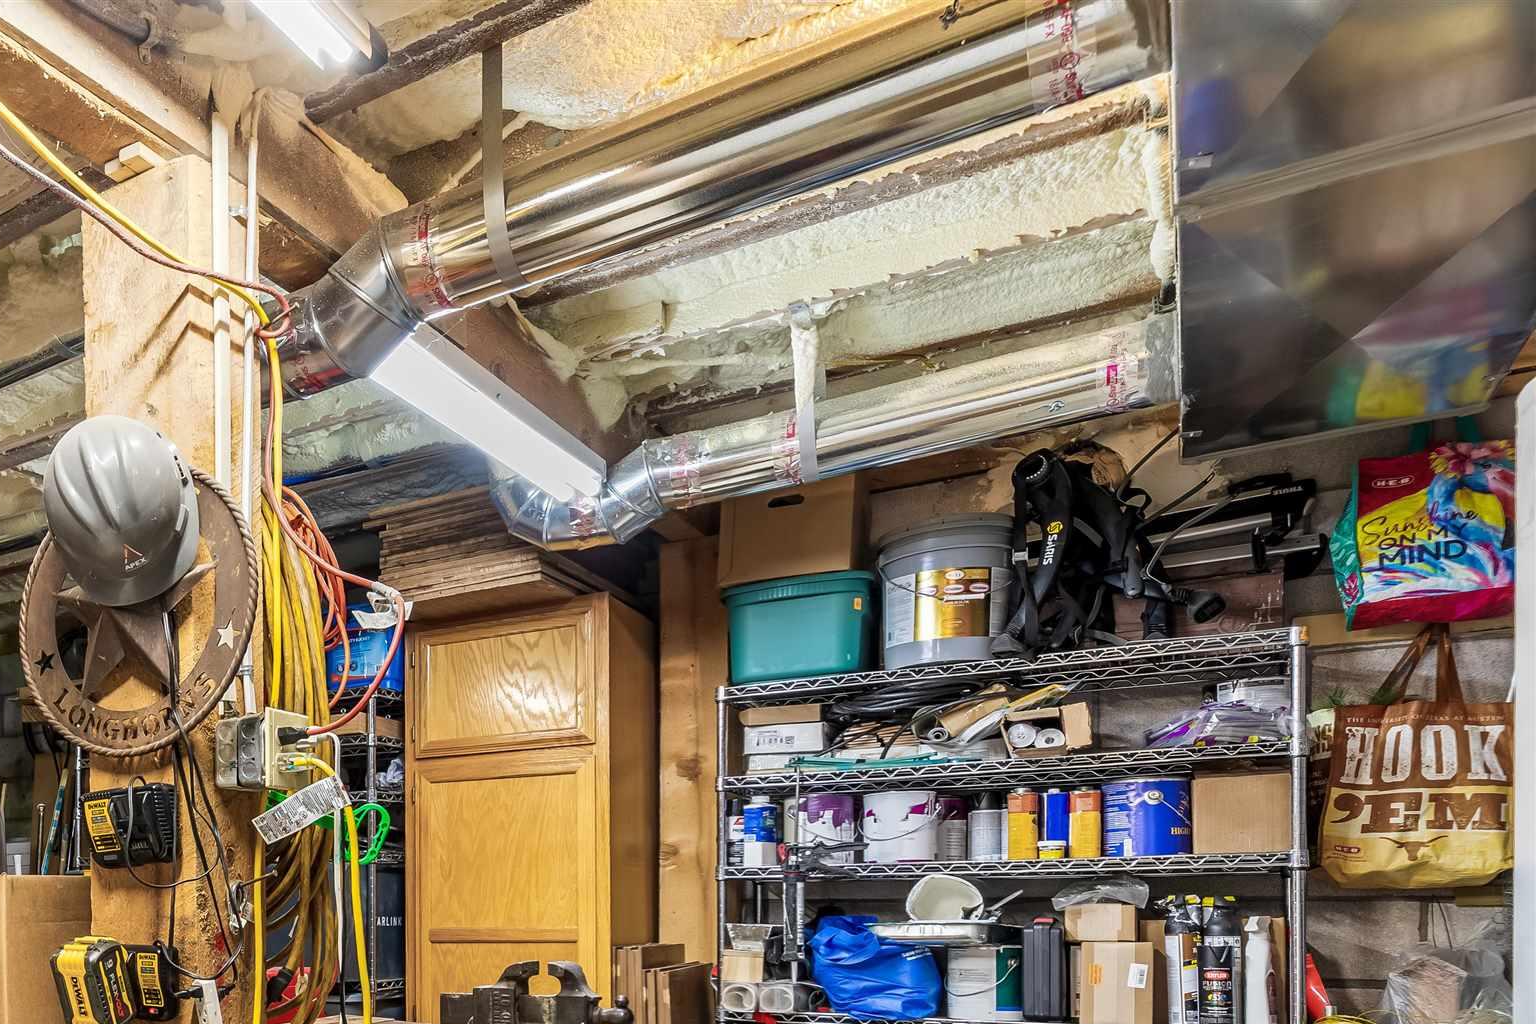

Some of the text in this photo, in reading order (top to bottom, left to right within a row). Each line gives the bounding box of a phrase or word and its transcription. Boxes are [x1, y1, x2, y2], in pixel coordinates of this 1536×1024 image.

[1271, 485, 1304, 496] THULE
[1362, 500, 1480, 545] Sunshine
[1378, 522, 1468, 550] ON MY
[124, 556, 148, 572] APEX
[1042, 533, 1058, 566] SARIS
[1378, 539, 1469, 569] MIND
[1339, 724, 1508, 785] HOOK
[71, 976, 88, 1017] DEWALT
